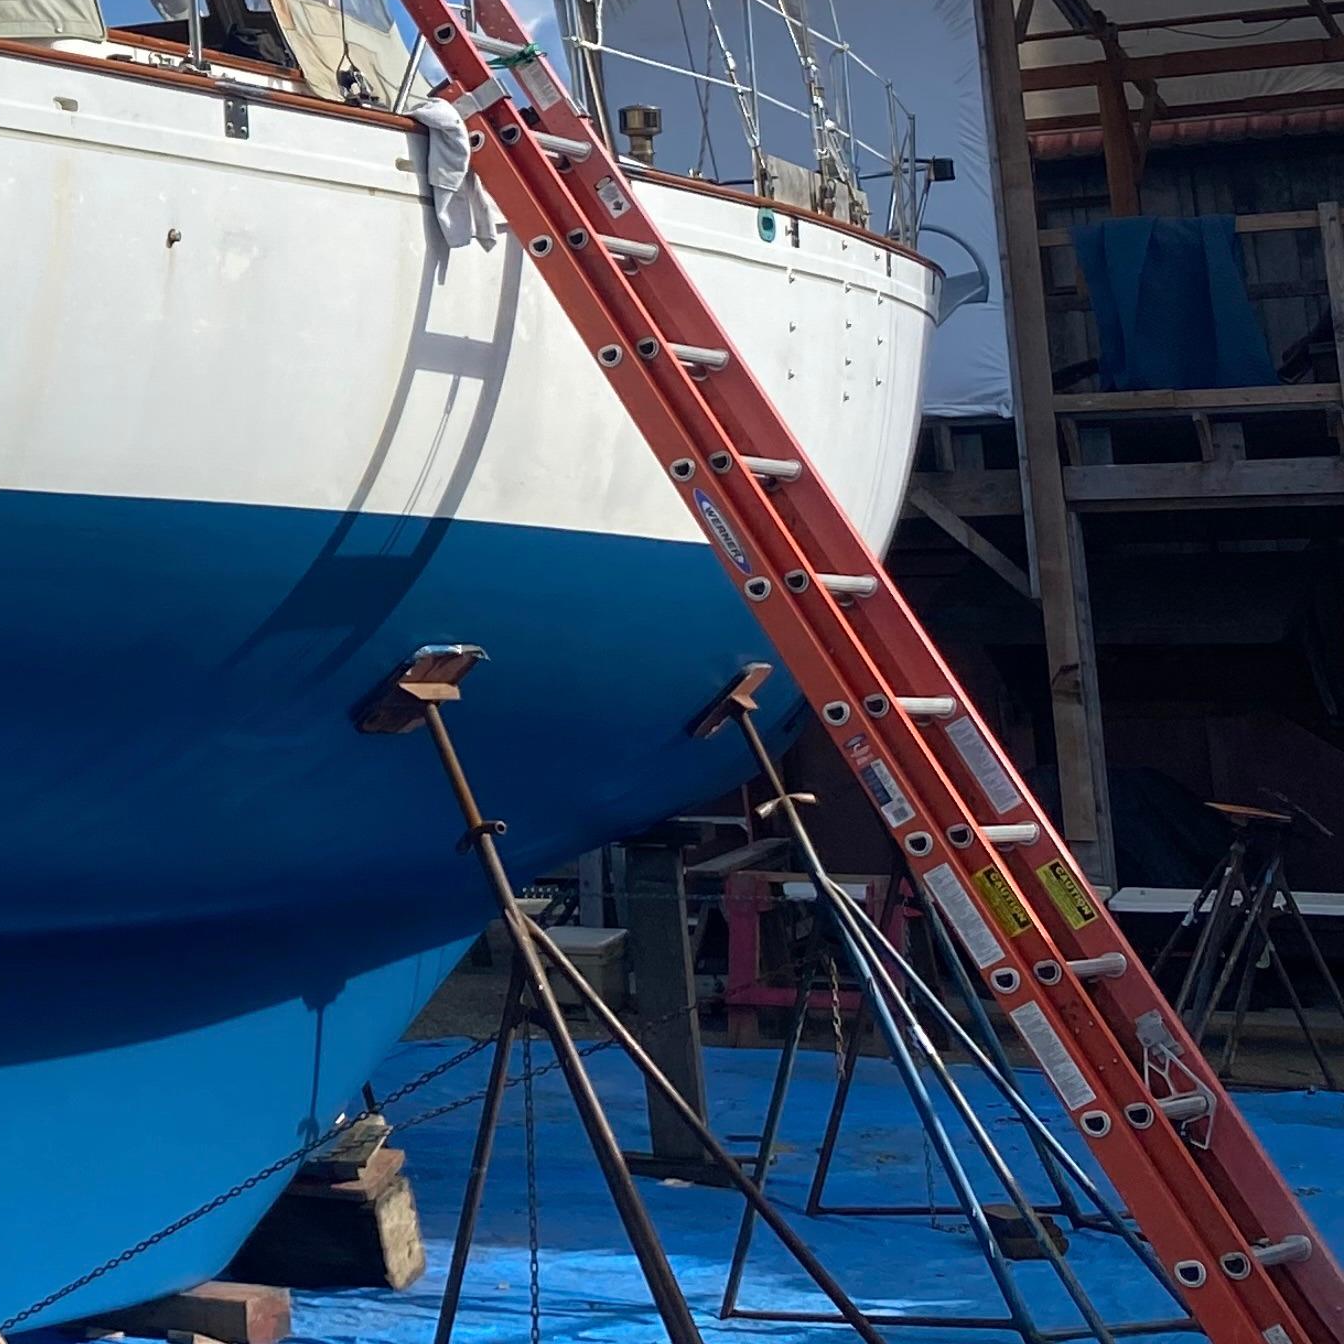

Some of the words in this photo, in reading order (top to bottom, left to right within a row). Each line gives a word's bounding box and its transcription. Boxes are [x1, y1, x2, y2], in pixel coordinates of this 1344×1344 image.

[704, 505, 743, 558] WERNER
[989, 871, 1028, 924] CAUTION
[1054, 864, 1093, 916] CAUTION
